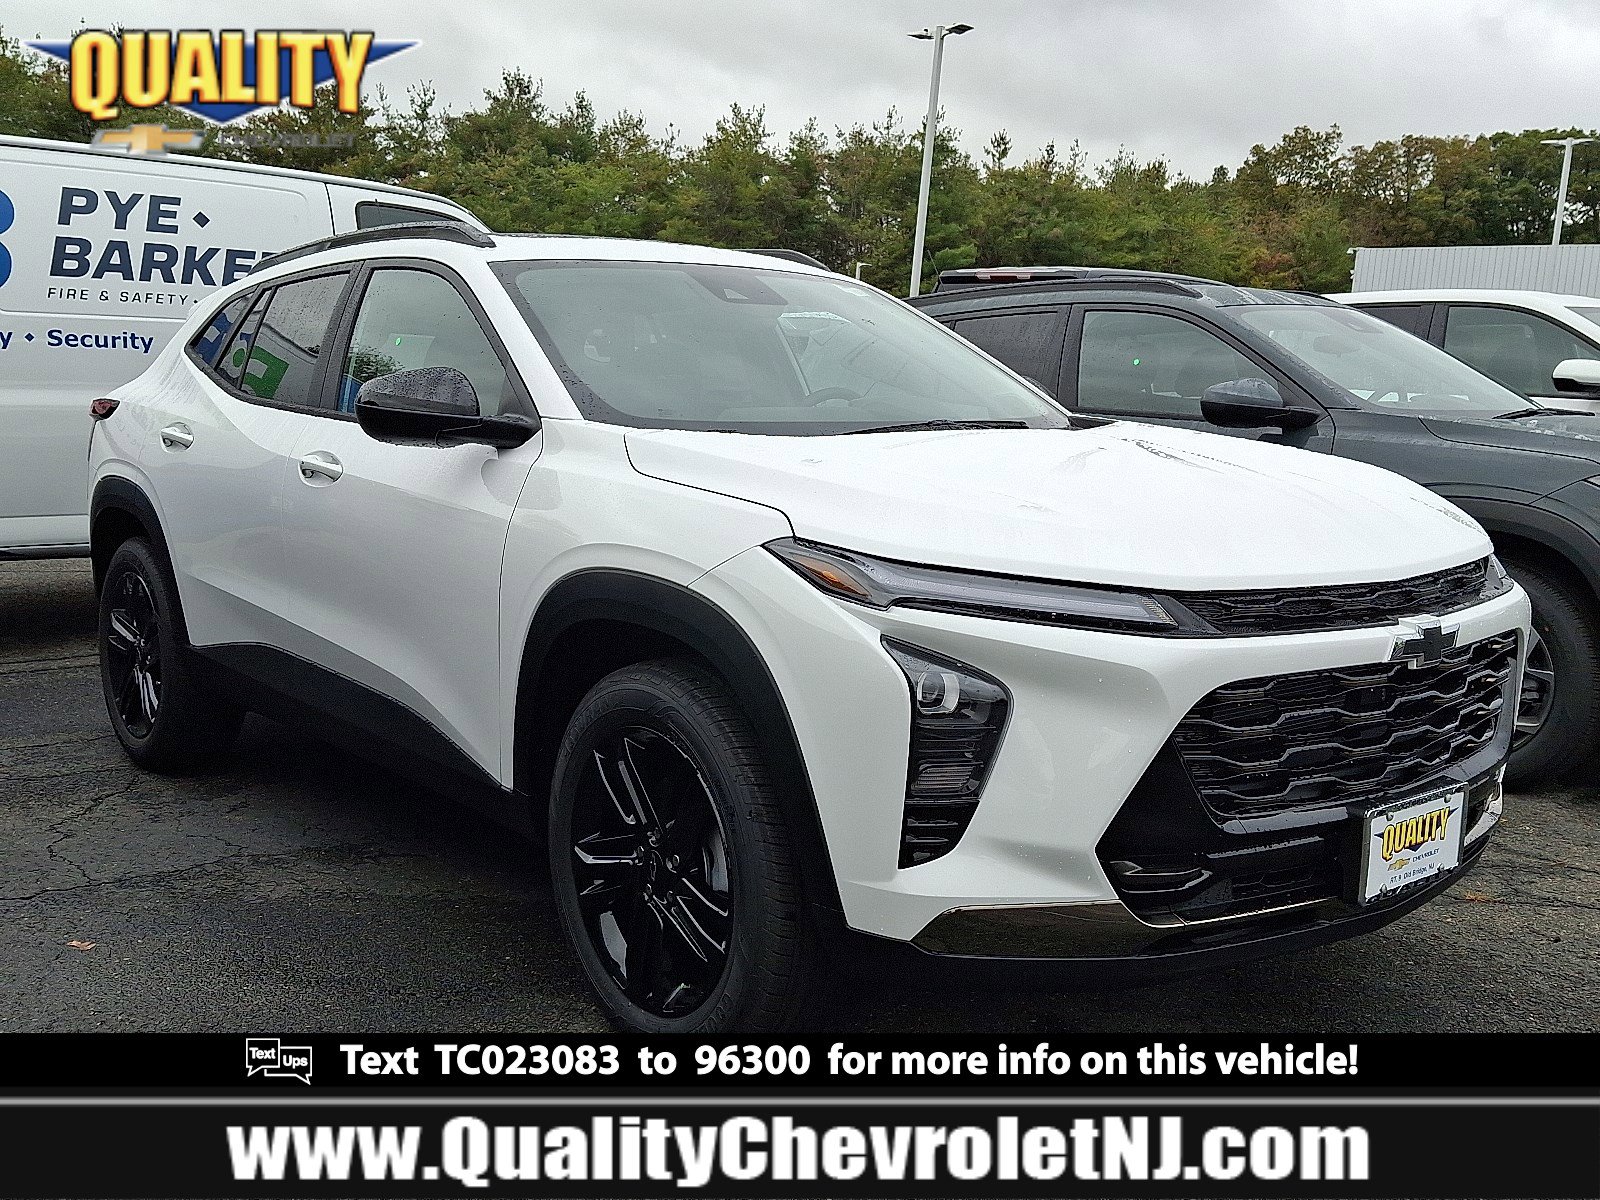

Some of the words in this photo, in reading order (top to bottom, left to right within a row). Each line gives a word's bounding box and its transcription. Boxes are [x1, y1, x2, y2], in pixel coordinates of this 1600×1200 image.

[57, 186, 182, 235] PYE
[47, 287, 89, 301] FIRE
[98, 290, 109, 302] &
[119, 291, 189, 305] SAFETY
[47, 329, 154, 354] Security
[1381, 806, 1451, 862] QUALITY
[1412, 847, 1440, 863] CHEVROLET
[1403, 871, 1412, 880] Old
[1428, 862, 1435, 870] NJ
